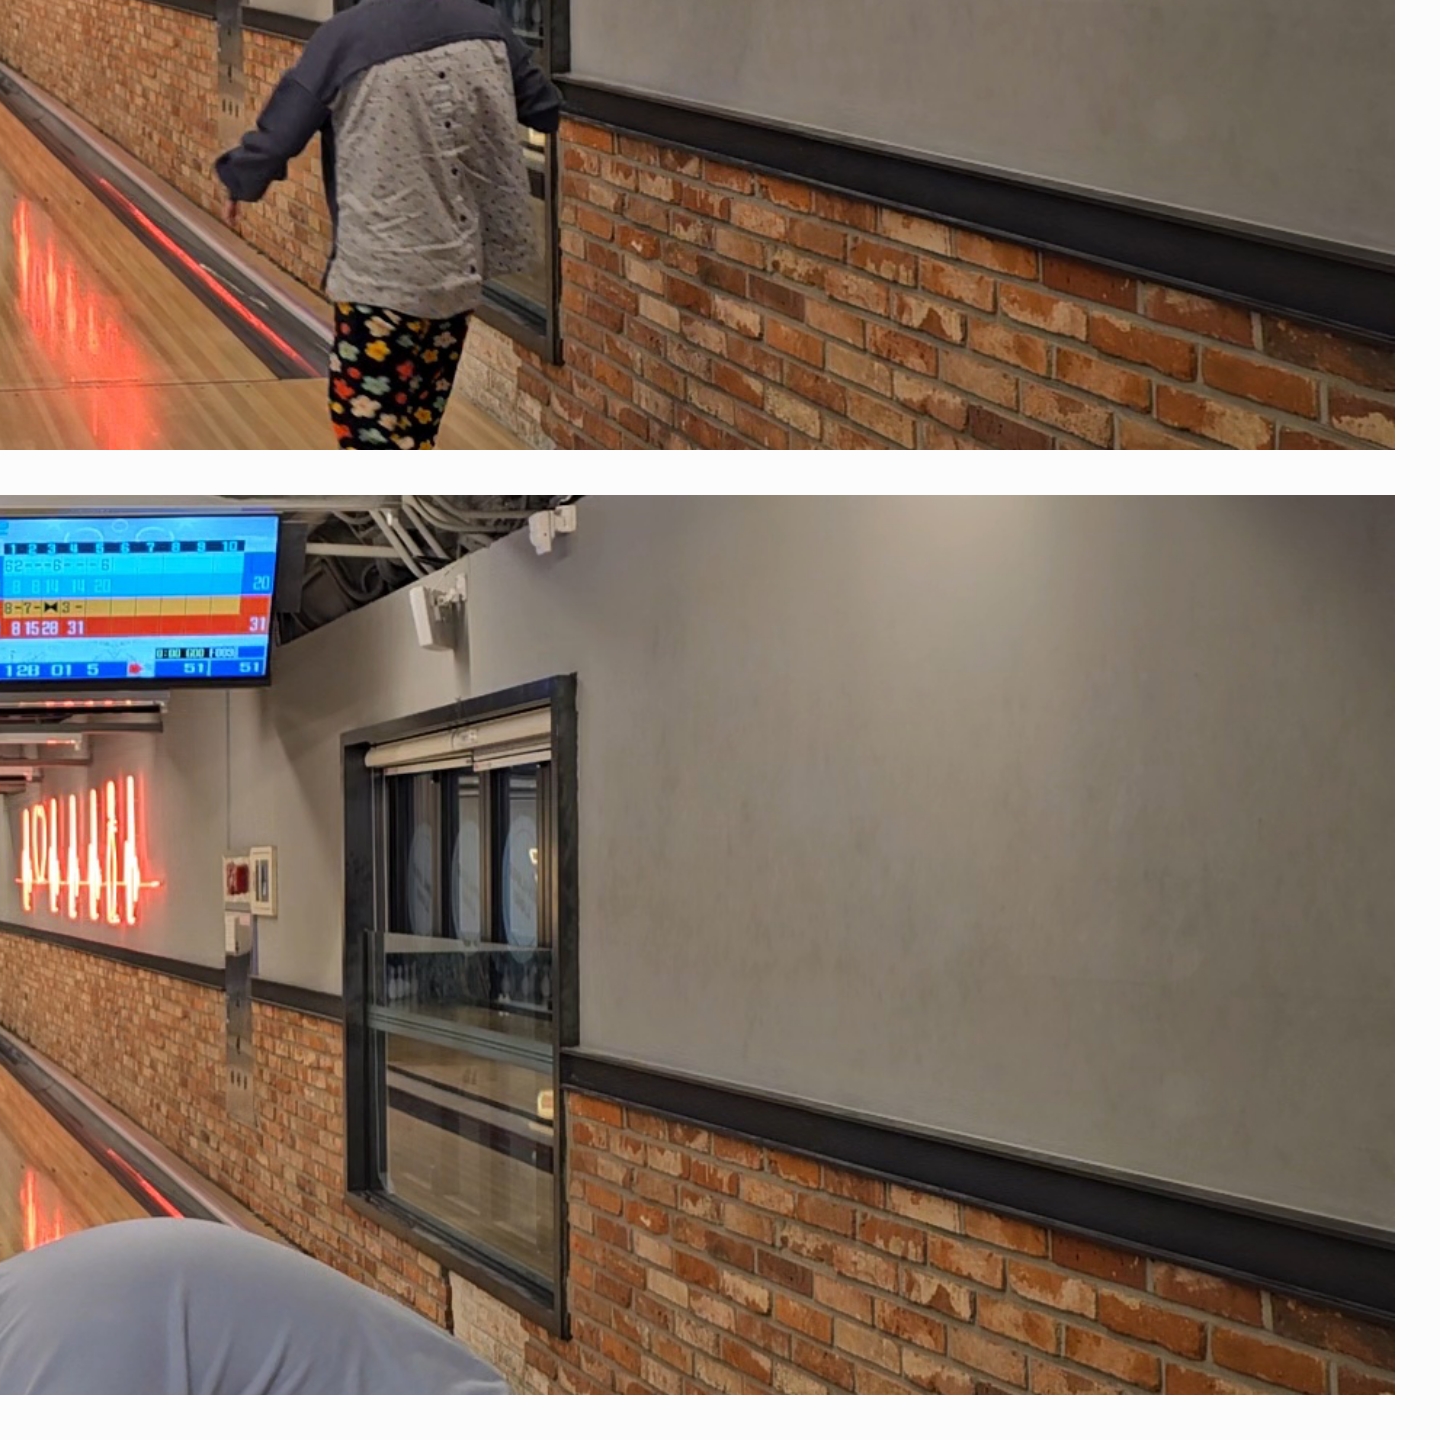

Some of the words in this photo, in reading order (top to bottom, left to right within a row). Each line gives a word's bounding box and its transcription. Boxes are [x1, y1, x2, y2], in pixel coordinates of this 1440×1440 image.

[253, 576, 269, 590] 20
[67, 621, 84, 634] 31
[249, 618, 266, 631] 31
[51, 664, 71, 675] 01
[87, 664, 99, 675] 5
[184, 663, 204, 673] 51
[239, 662, 259, 672] 51
